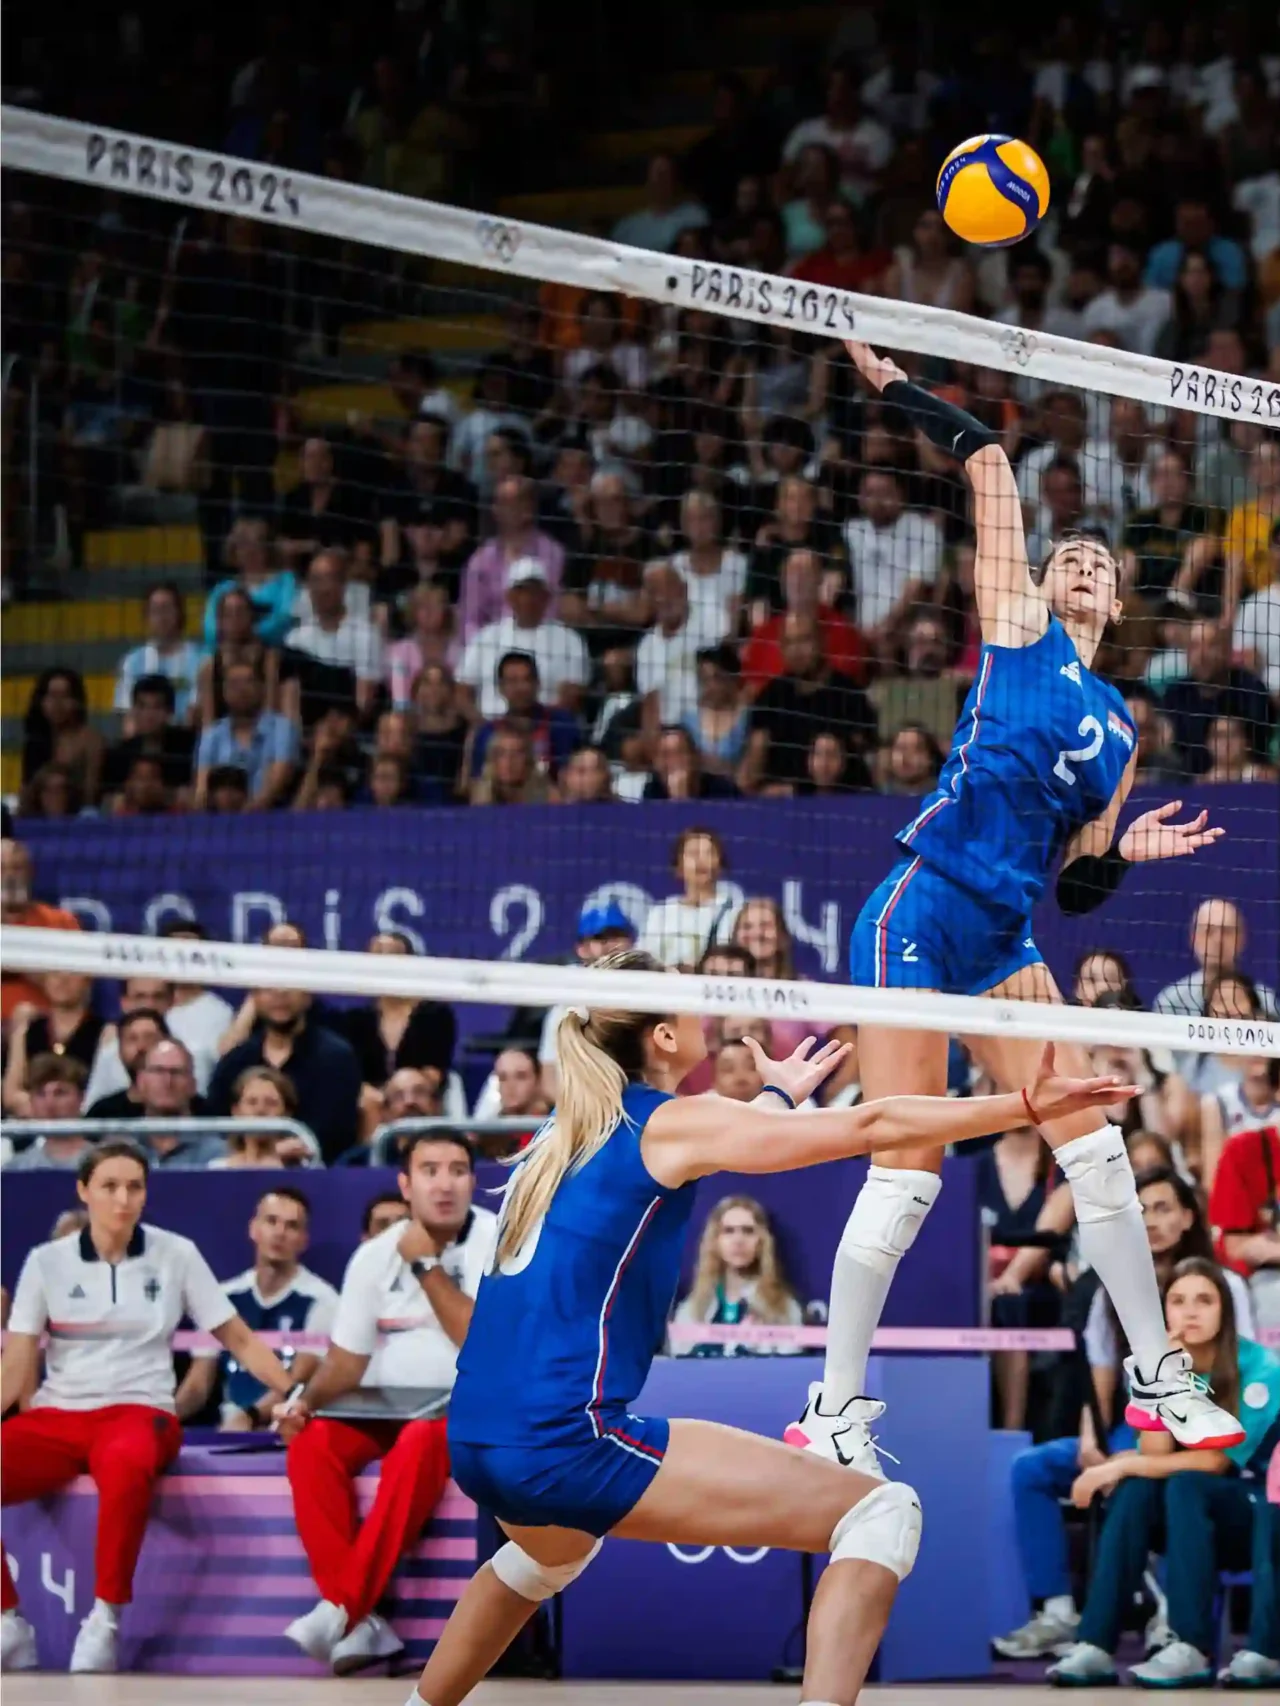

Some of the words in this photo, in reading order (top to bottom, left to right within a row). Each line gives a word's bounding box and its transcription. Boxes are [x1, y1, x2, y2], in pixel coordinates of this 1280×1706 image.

[207, 160, 300, 216] 2024
[783, 285, 855, 330] 2024
[1053, 715, 1104, 786] 2
